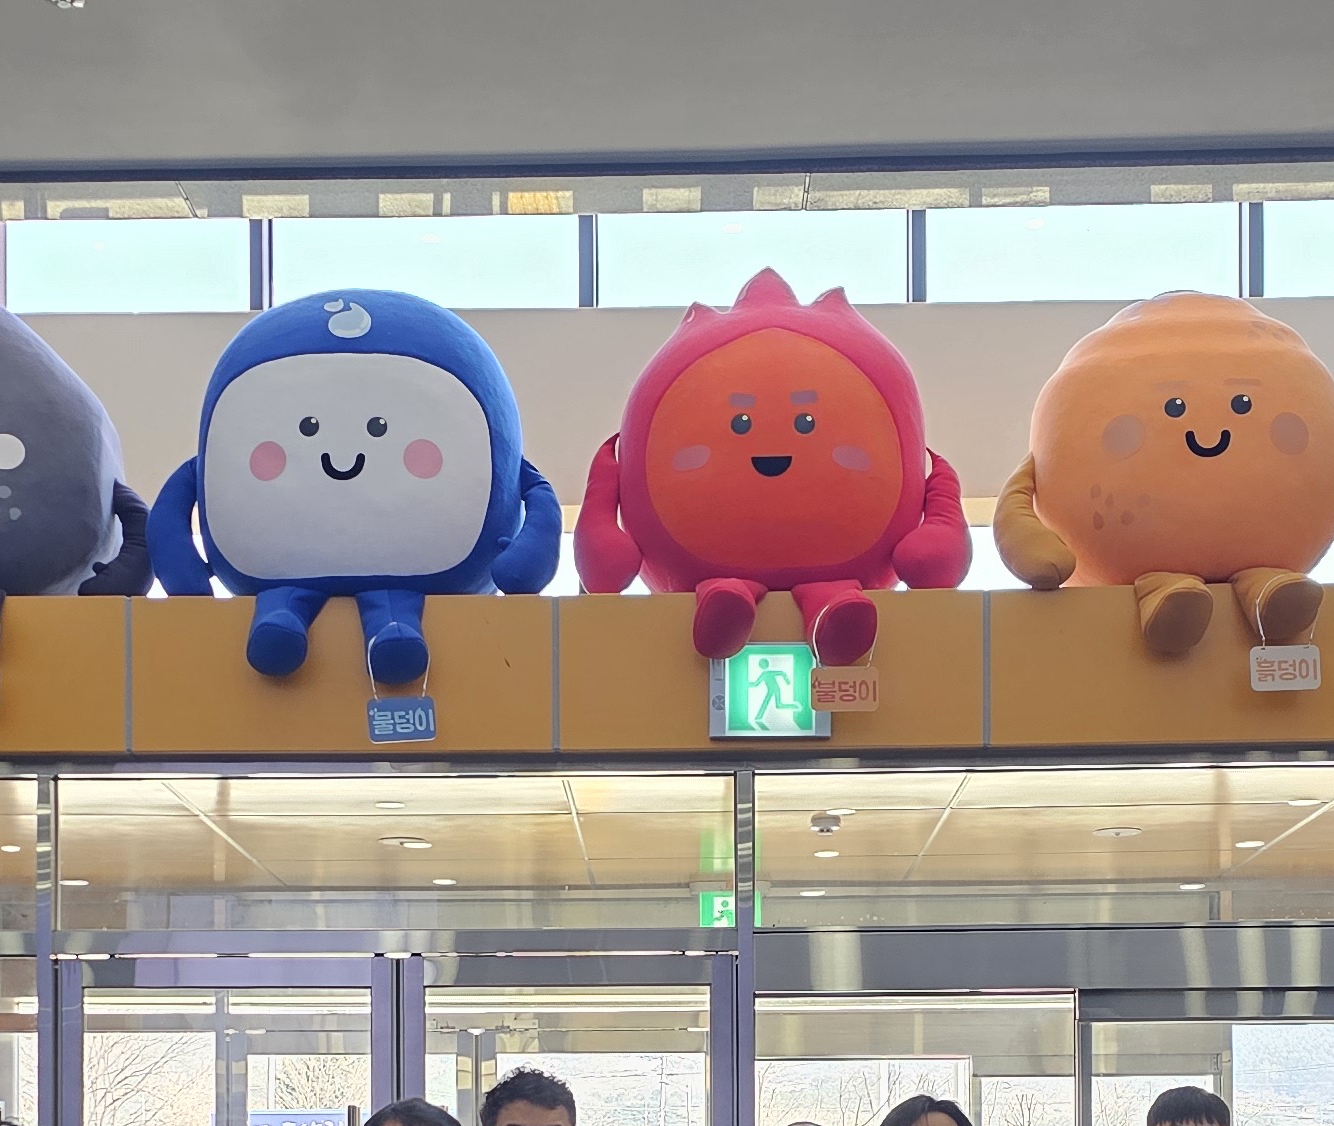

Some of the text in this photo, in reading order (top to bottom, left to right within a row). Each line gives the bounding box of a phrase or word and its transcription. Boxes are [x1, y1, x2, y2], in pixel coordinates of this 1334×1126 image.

[1255, 657, 1317, 682] 흙덩이
[812, 678, 877, 703] 불덩이
[370, 707, 434, 735] 물덩이
